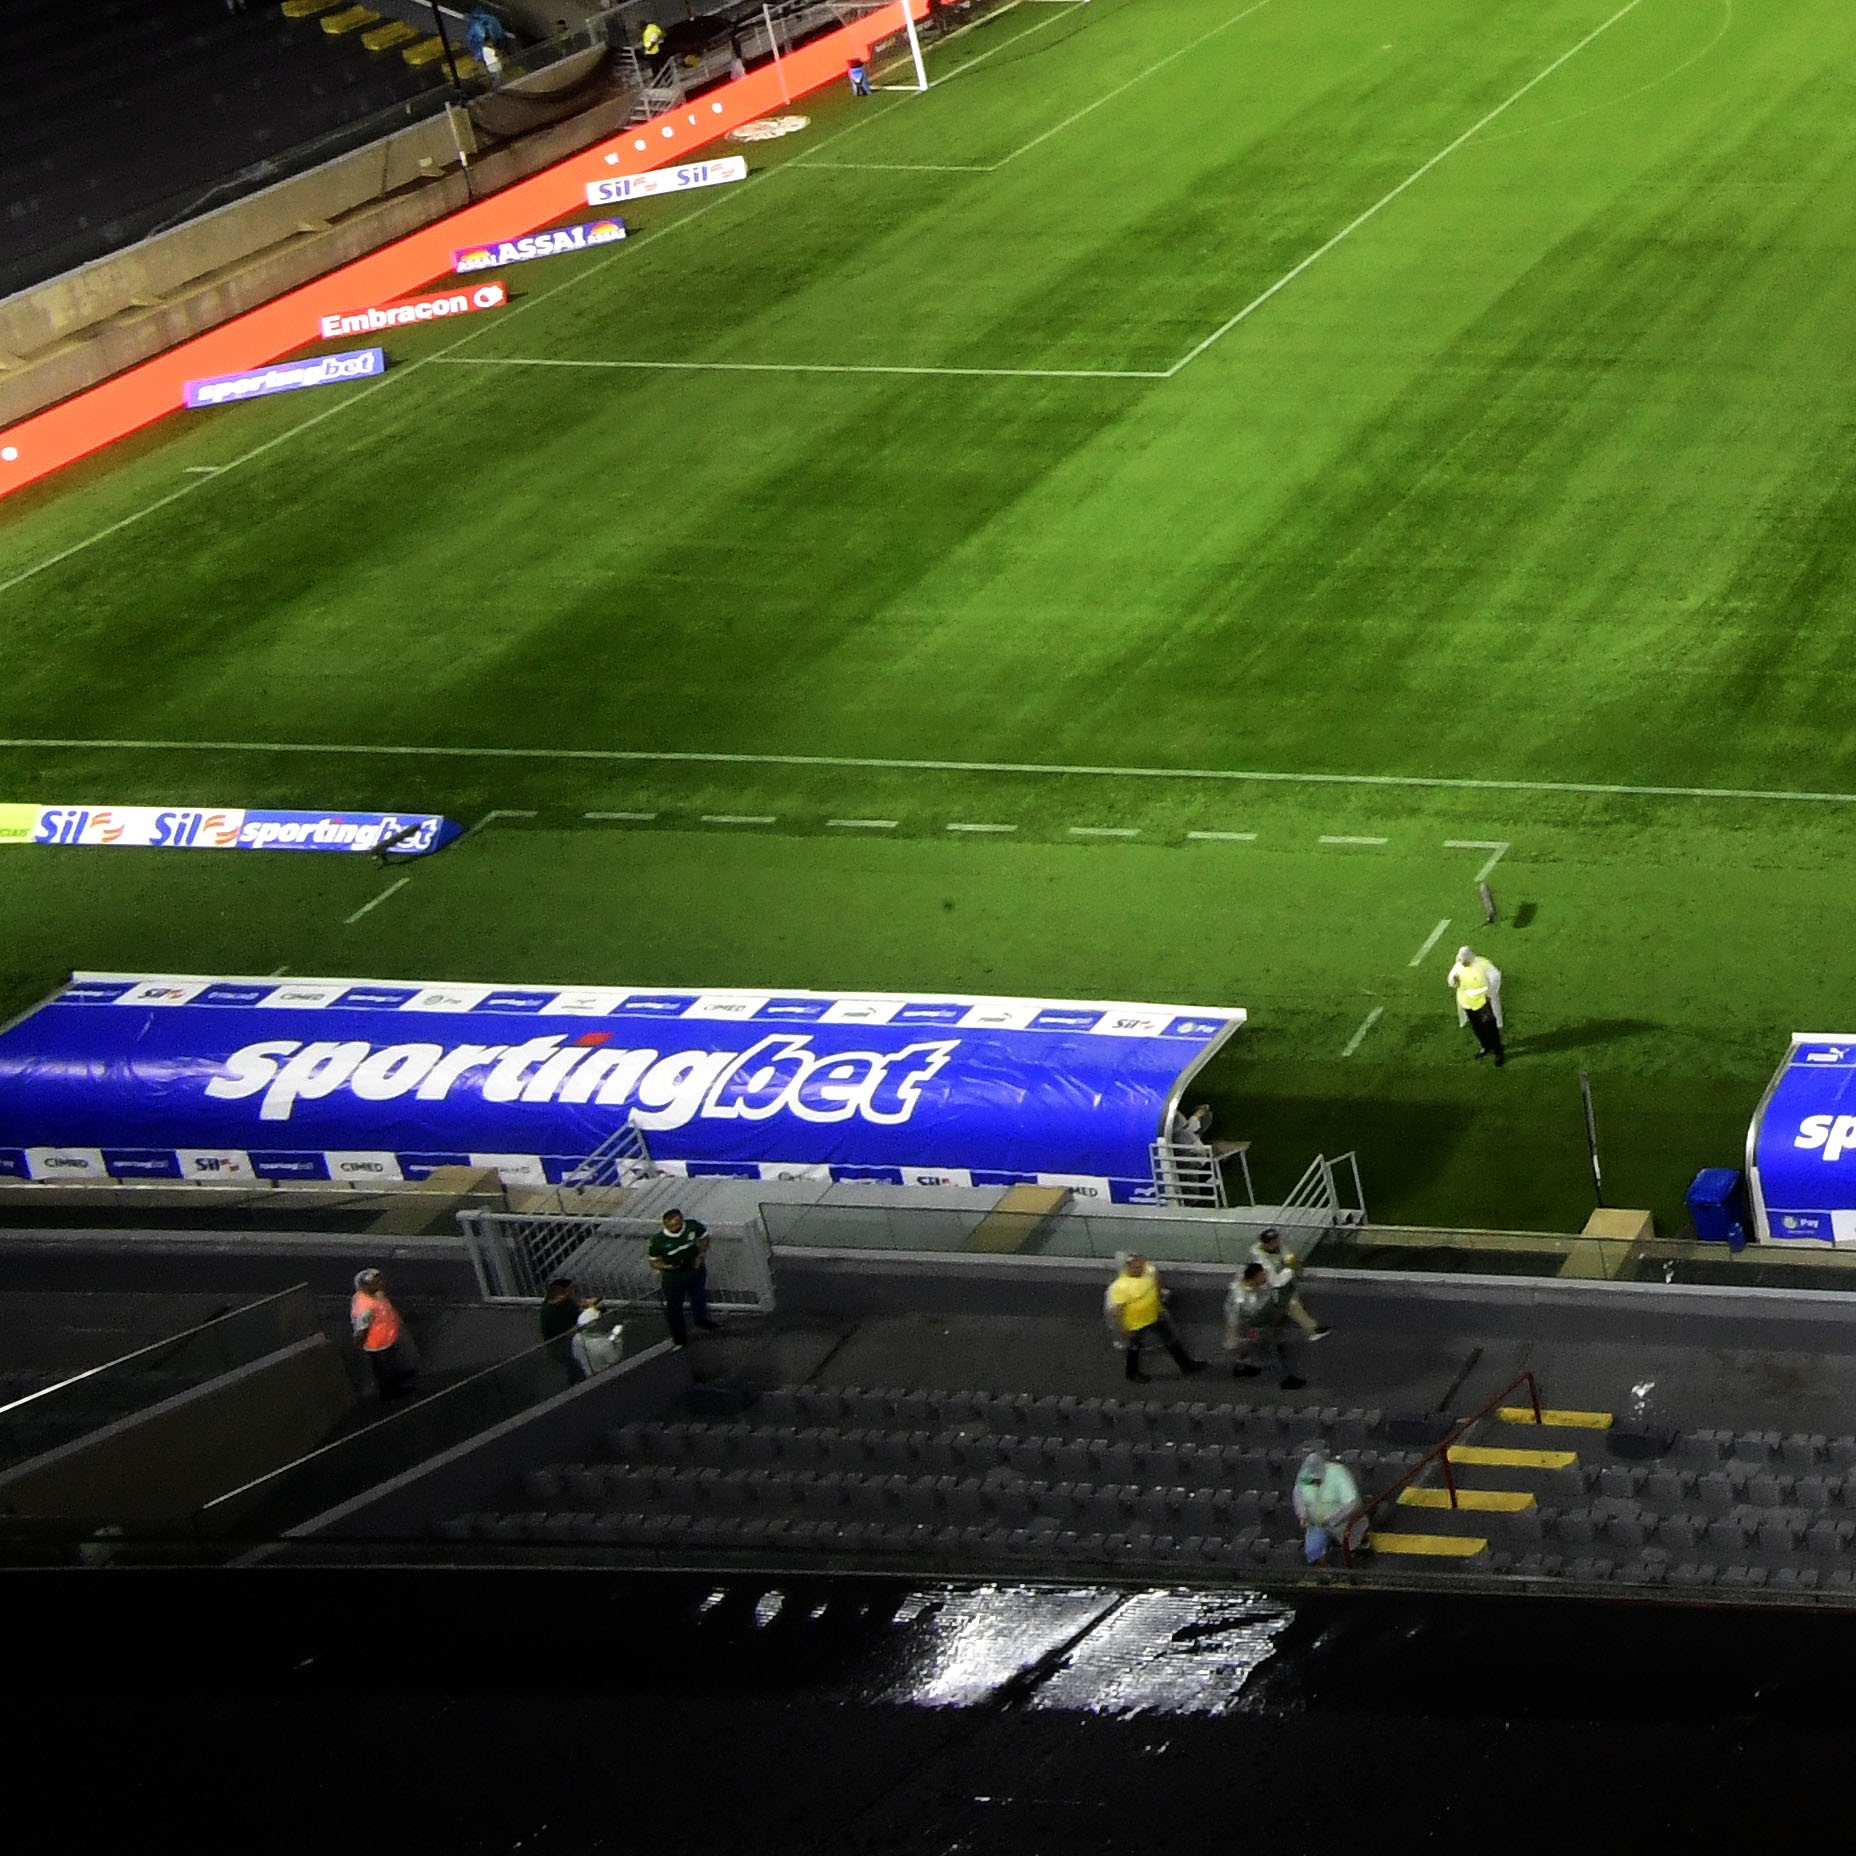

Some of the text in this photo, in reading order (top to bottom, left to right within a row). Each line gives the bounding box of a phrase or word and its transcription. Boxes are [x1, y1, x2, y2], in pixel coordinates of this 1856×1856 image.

[598, 166, 708, 200] Sil Sil
[320, 295, 468, 338] Embracon
[197, 350, 375, 401] sportingbet
[34, 810, 90, 844] Sil
[149, 812, 204, 846] Sil
[205, 1031, 961, 1131] sportingbet
